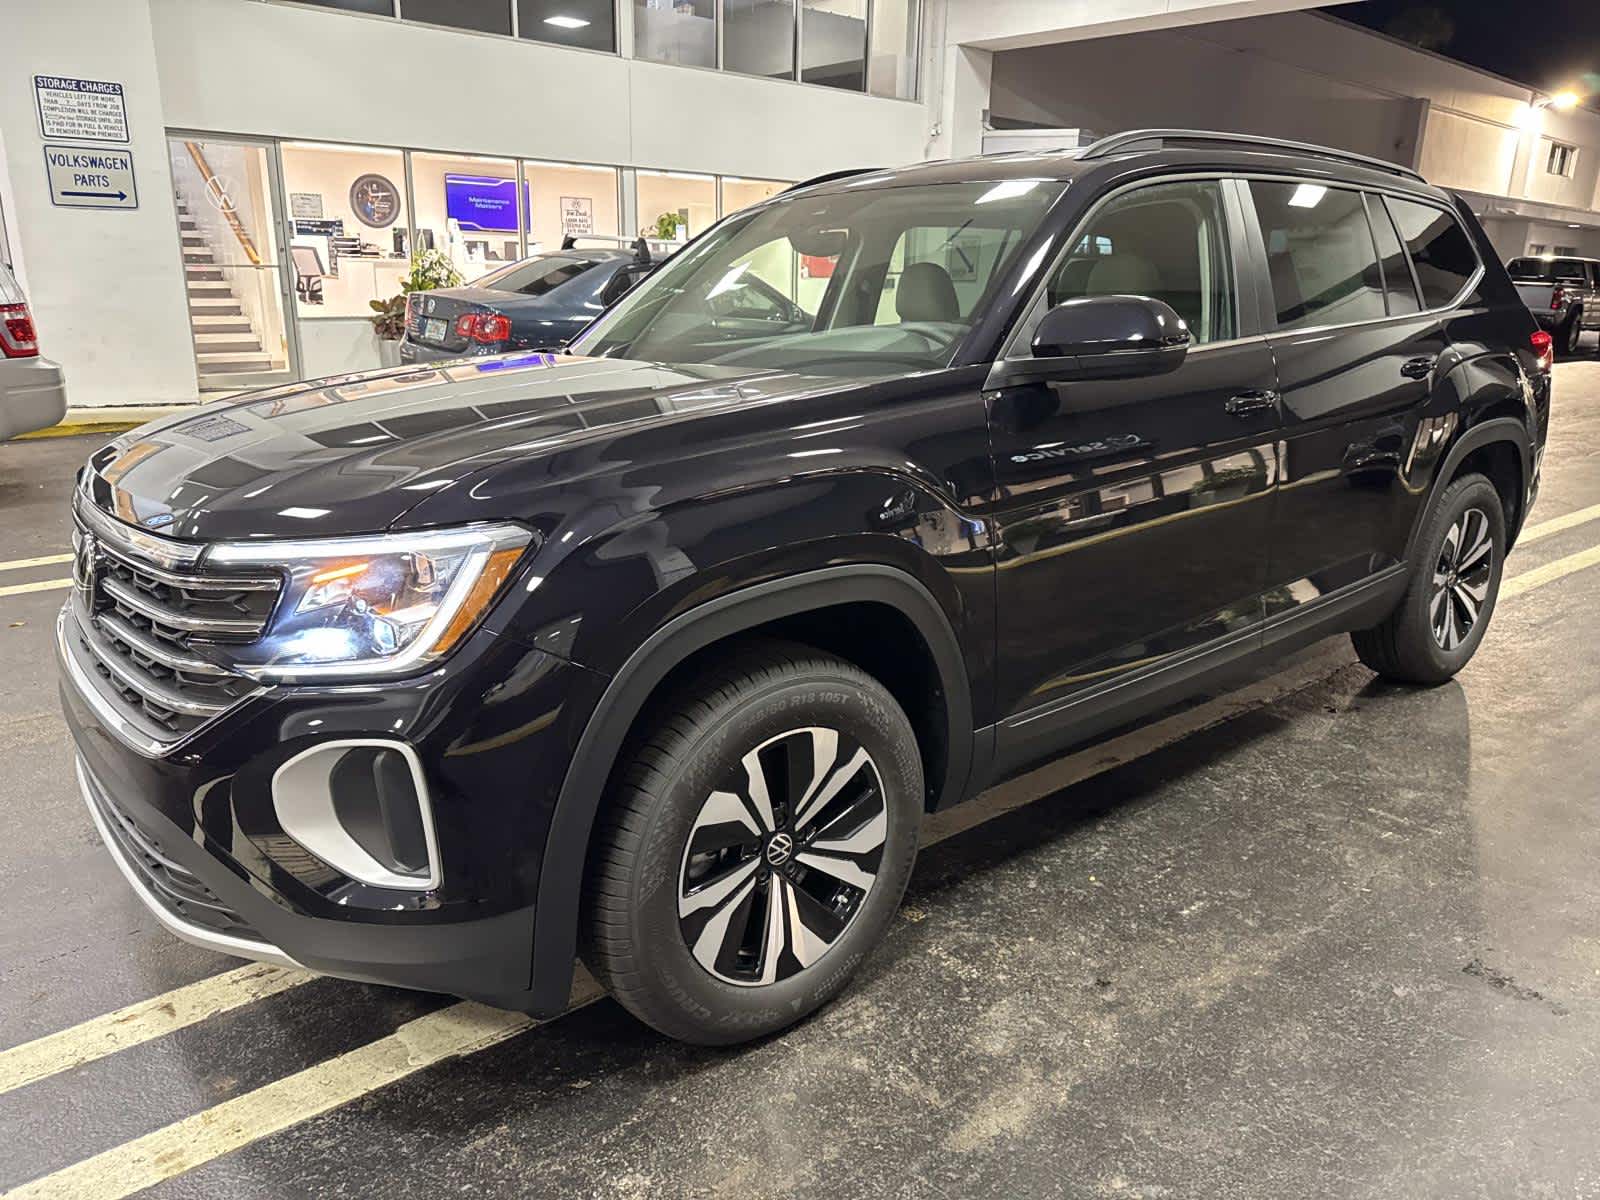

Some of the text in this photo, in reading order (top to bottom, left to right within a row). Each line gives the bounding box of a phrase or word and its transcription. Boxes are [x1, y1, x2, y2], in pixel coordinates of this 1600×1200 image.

[37, 77, 121, 94] STORAGE CHARGES
[45, 91, 72, 99] VEHICLES
[43, 105, 76, 113] COMPLETION
[49, 153, 128, 170] VOLKSWAGEN
[73, 174, 110, 188] PARTS
[468, 196, 510, 205] Maintenance
[818, 692, 850, 704] 105T
